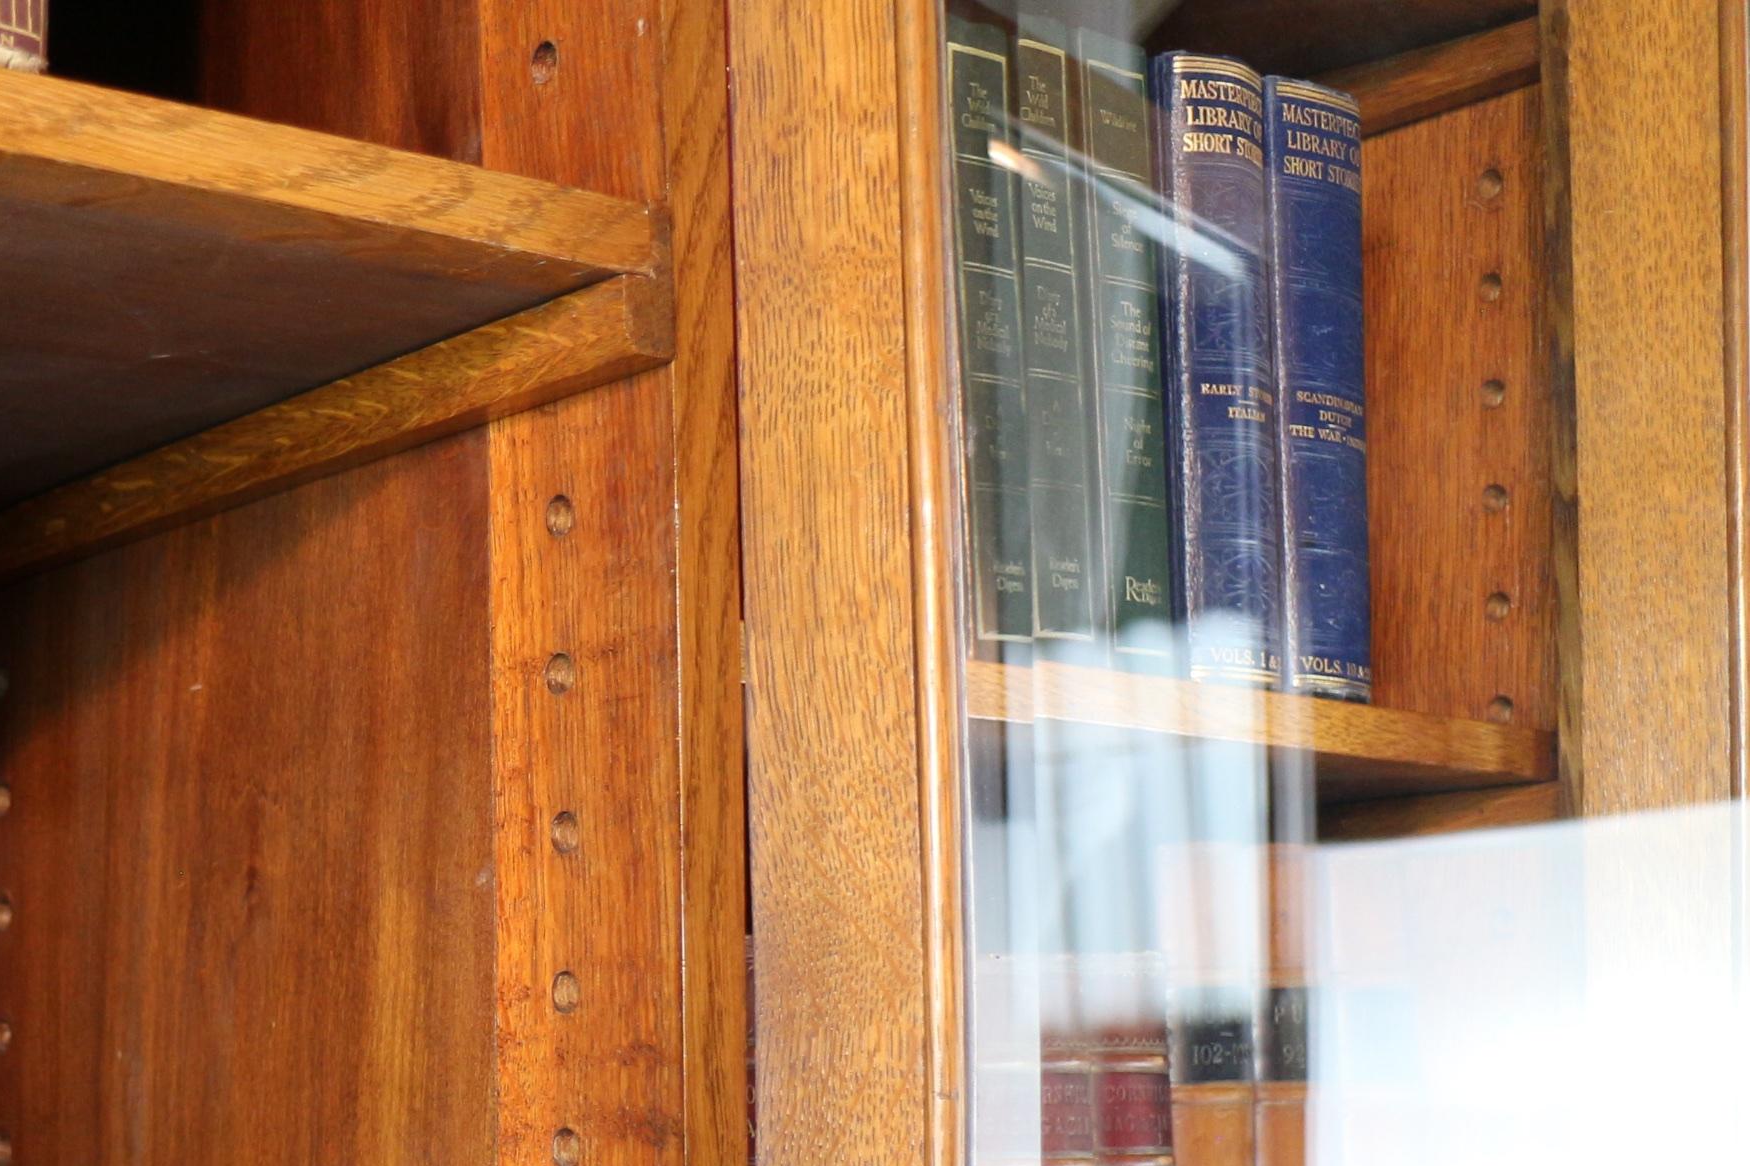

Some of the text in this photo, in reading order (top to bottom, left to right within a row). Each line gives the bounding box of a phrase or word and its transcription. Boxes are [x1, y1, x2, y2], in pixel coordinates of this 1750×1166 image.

[1028, 75, 1046, 92] The
[1180, 79, 1262, 118] MASTERPIEC
[1186, 105, 1253, 136] LIBRARY
[1281, 102, 1360, 141] MASTERPIEC
[1182, 131, 1233, 154] SHORT
[1287, 129, 1347, 161] LIBRARY
[1283, 155, 1323, 180] SHORT
[1027, 182, 1056, 203] Voices
[1033, 215, 1057, 233] Wind
[1119, 300, 1141, 318] The
[1110, 315, 1141, 334] Sound
[1200, 383, 1244, 397] EARLY
[1123, 416, 1152, 435] Night
[1289, 424, 1316, 439] THE
[1132, 434, 1144, 451] of
[1126, 449, 1153, 468] Error
